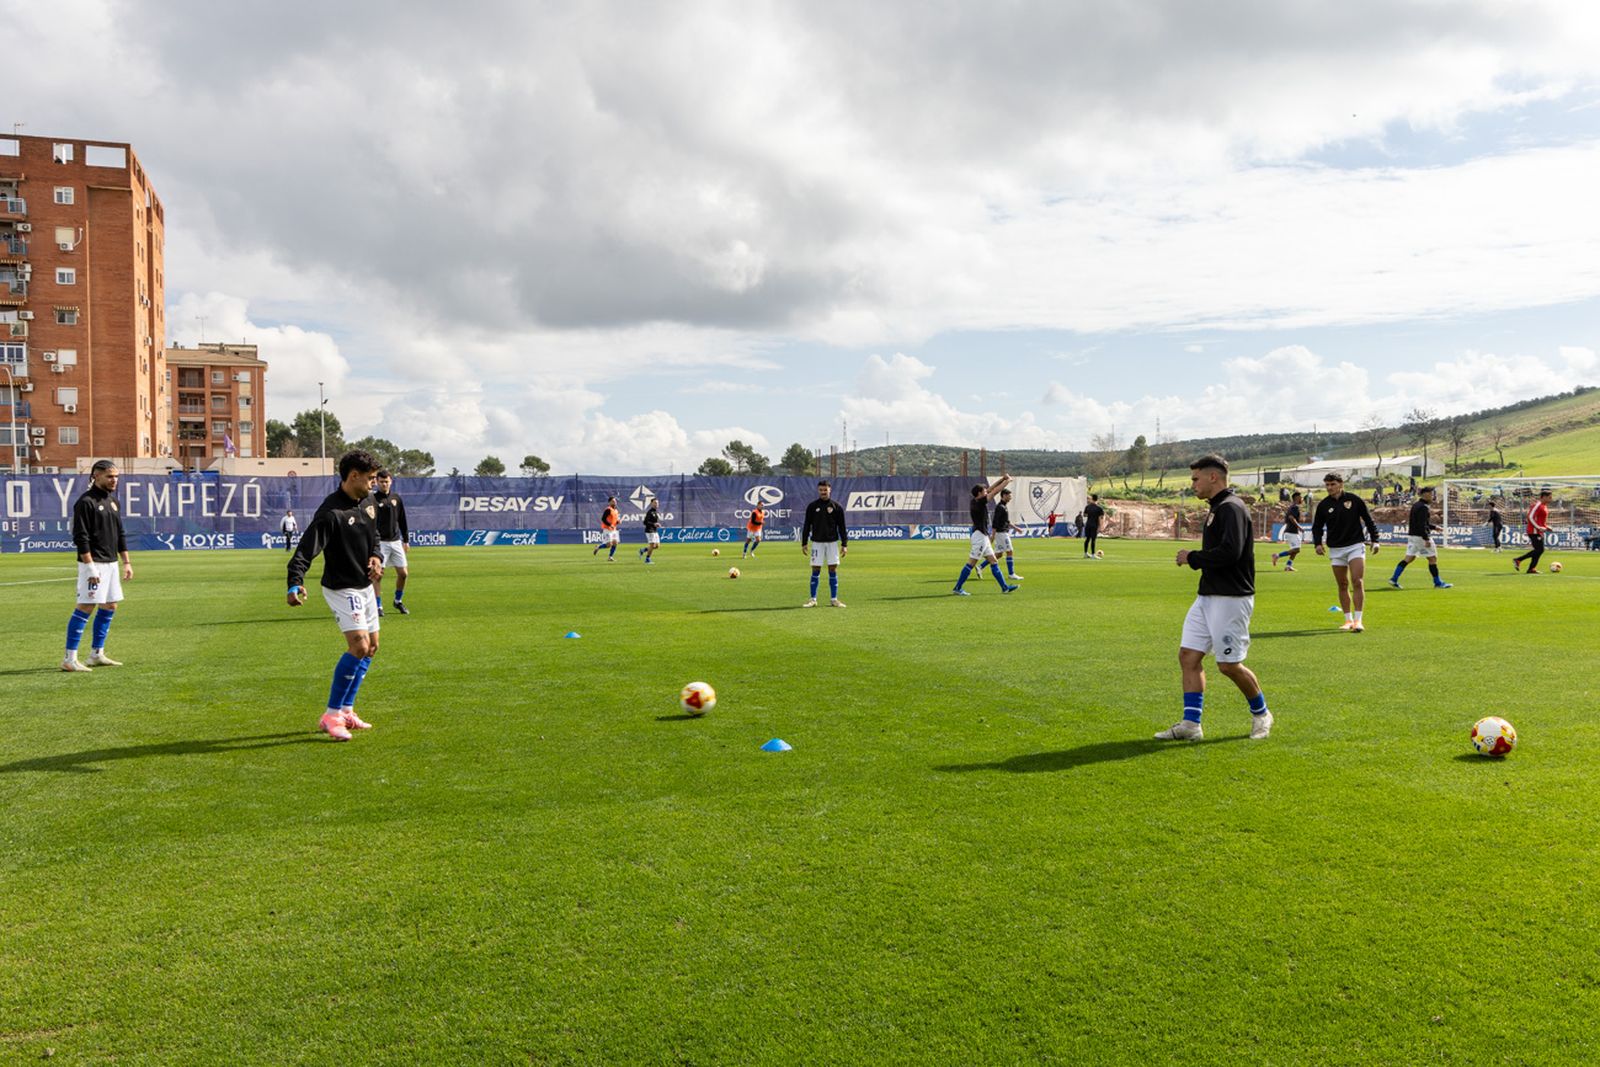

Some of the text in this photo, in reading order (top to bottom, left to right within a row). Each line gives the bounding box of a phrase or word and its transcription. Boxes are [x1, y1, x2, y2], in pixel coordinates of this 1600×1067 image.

[52, 478, 75, 518] Y
[125, 477, 261, 517] EMPEZÓ
[852, 494, 896, 508] ACTIA
[459, 496, 564, 512] DESAY SV
[617, 513, 674, 521] ANTNA
[734, 509, 792, 519] COONET
[30, 521, 45, 531] EN
[660, 529, 674, 540] La
[846, 527, 904, 539] apimueble
[183, 534, 234, 547] ROYSE
[512, 538, 536, 546] CAR
[347, 595, 363, 611] 19
